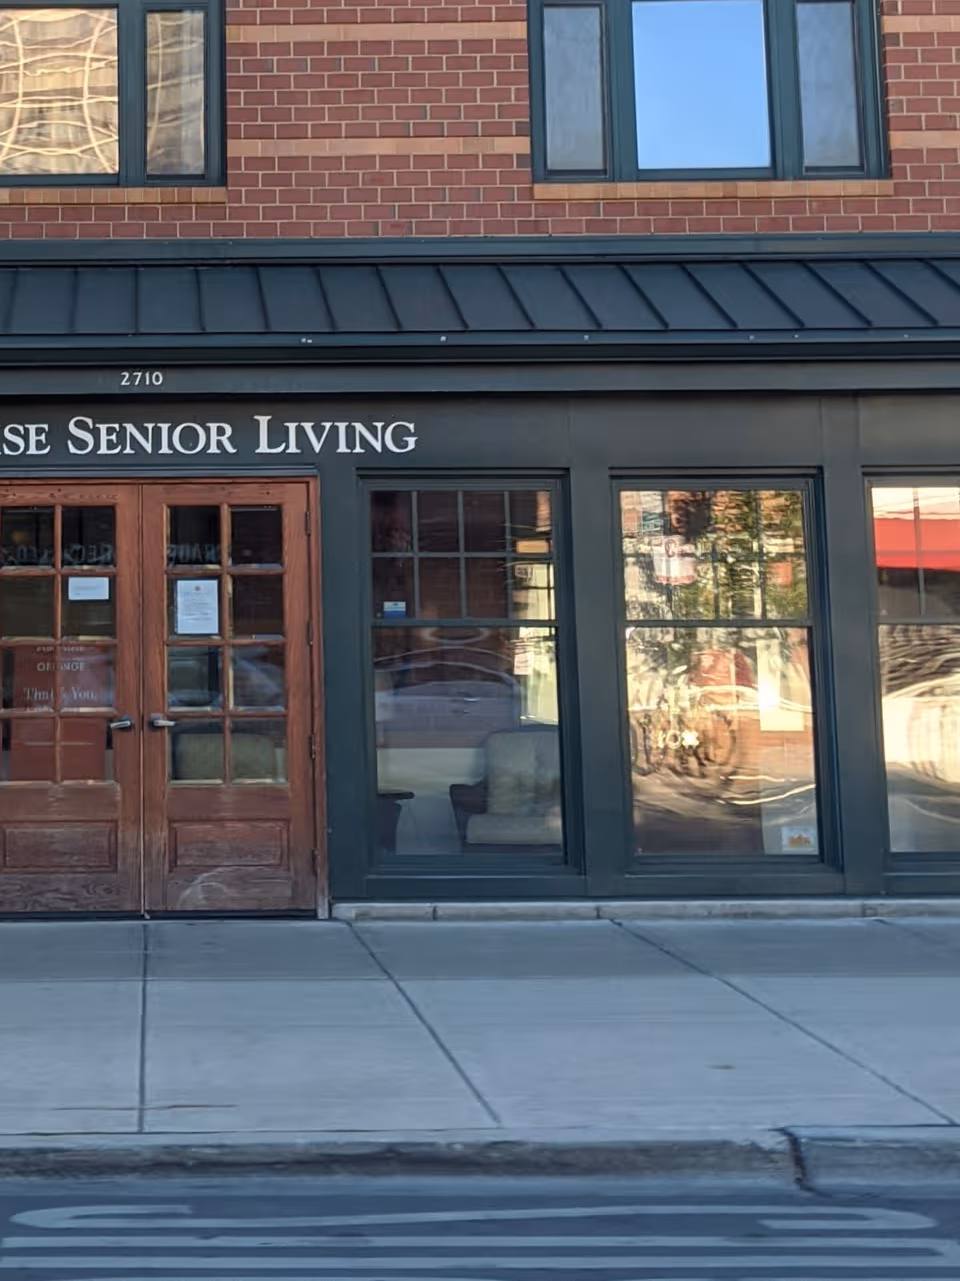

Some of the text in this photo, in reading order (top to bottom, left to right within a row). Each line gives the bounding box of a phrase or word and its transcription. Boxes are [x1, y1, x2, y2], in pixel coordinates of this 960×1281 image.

[120, 371, 164, 386] 2710
[66, 415, 238, 455] SENIOR
[253, 415, 419, 455] LIVING
